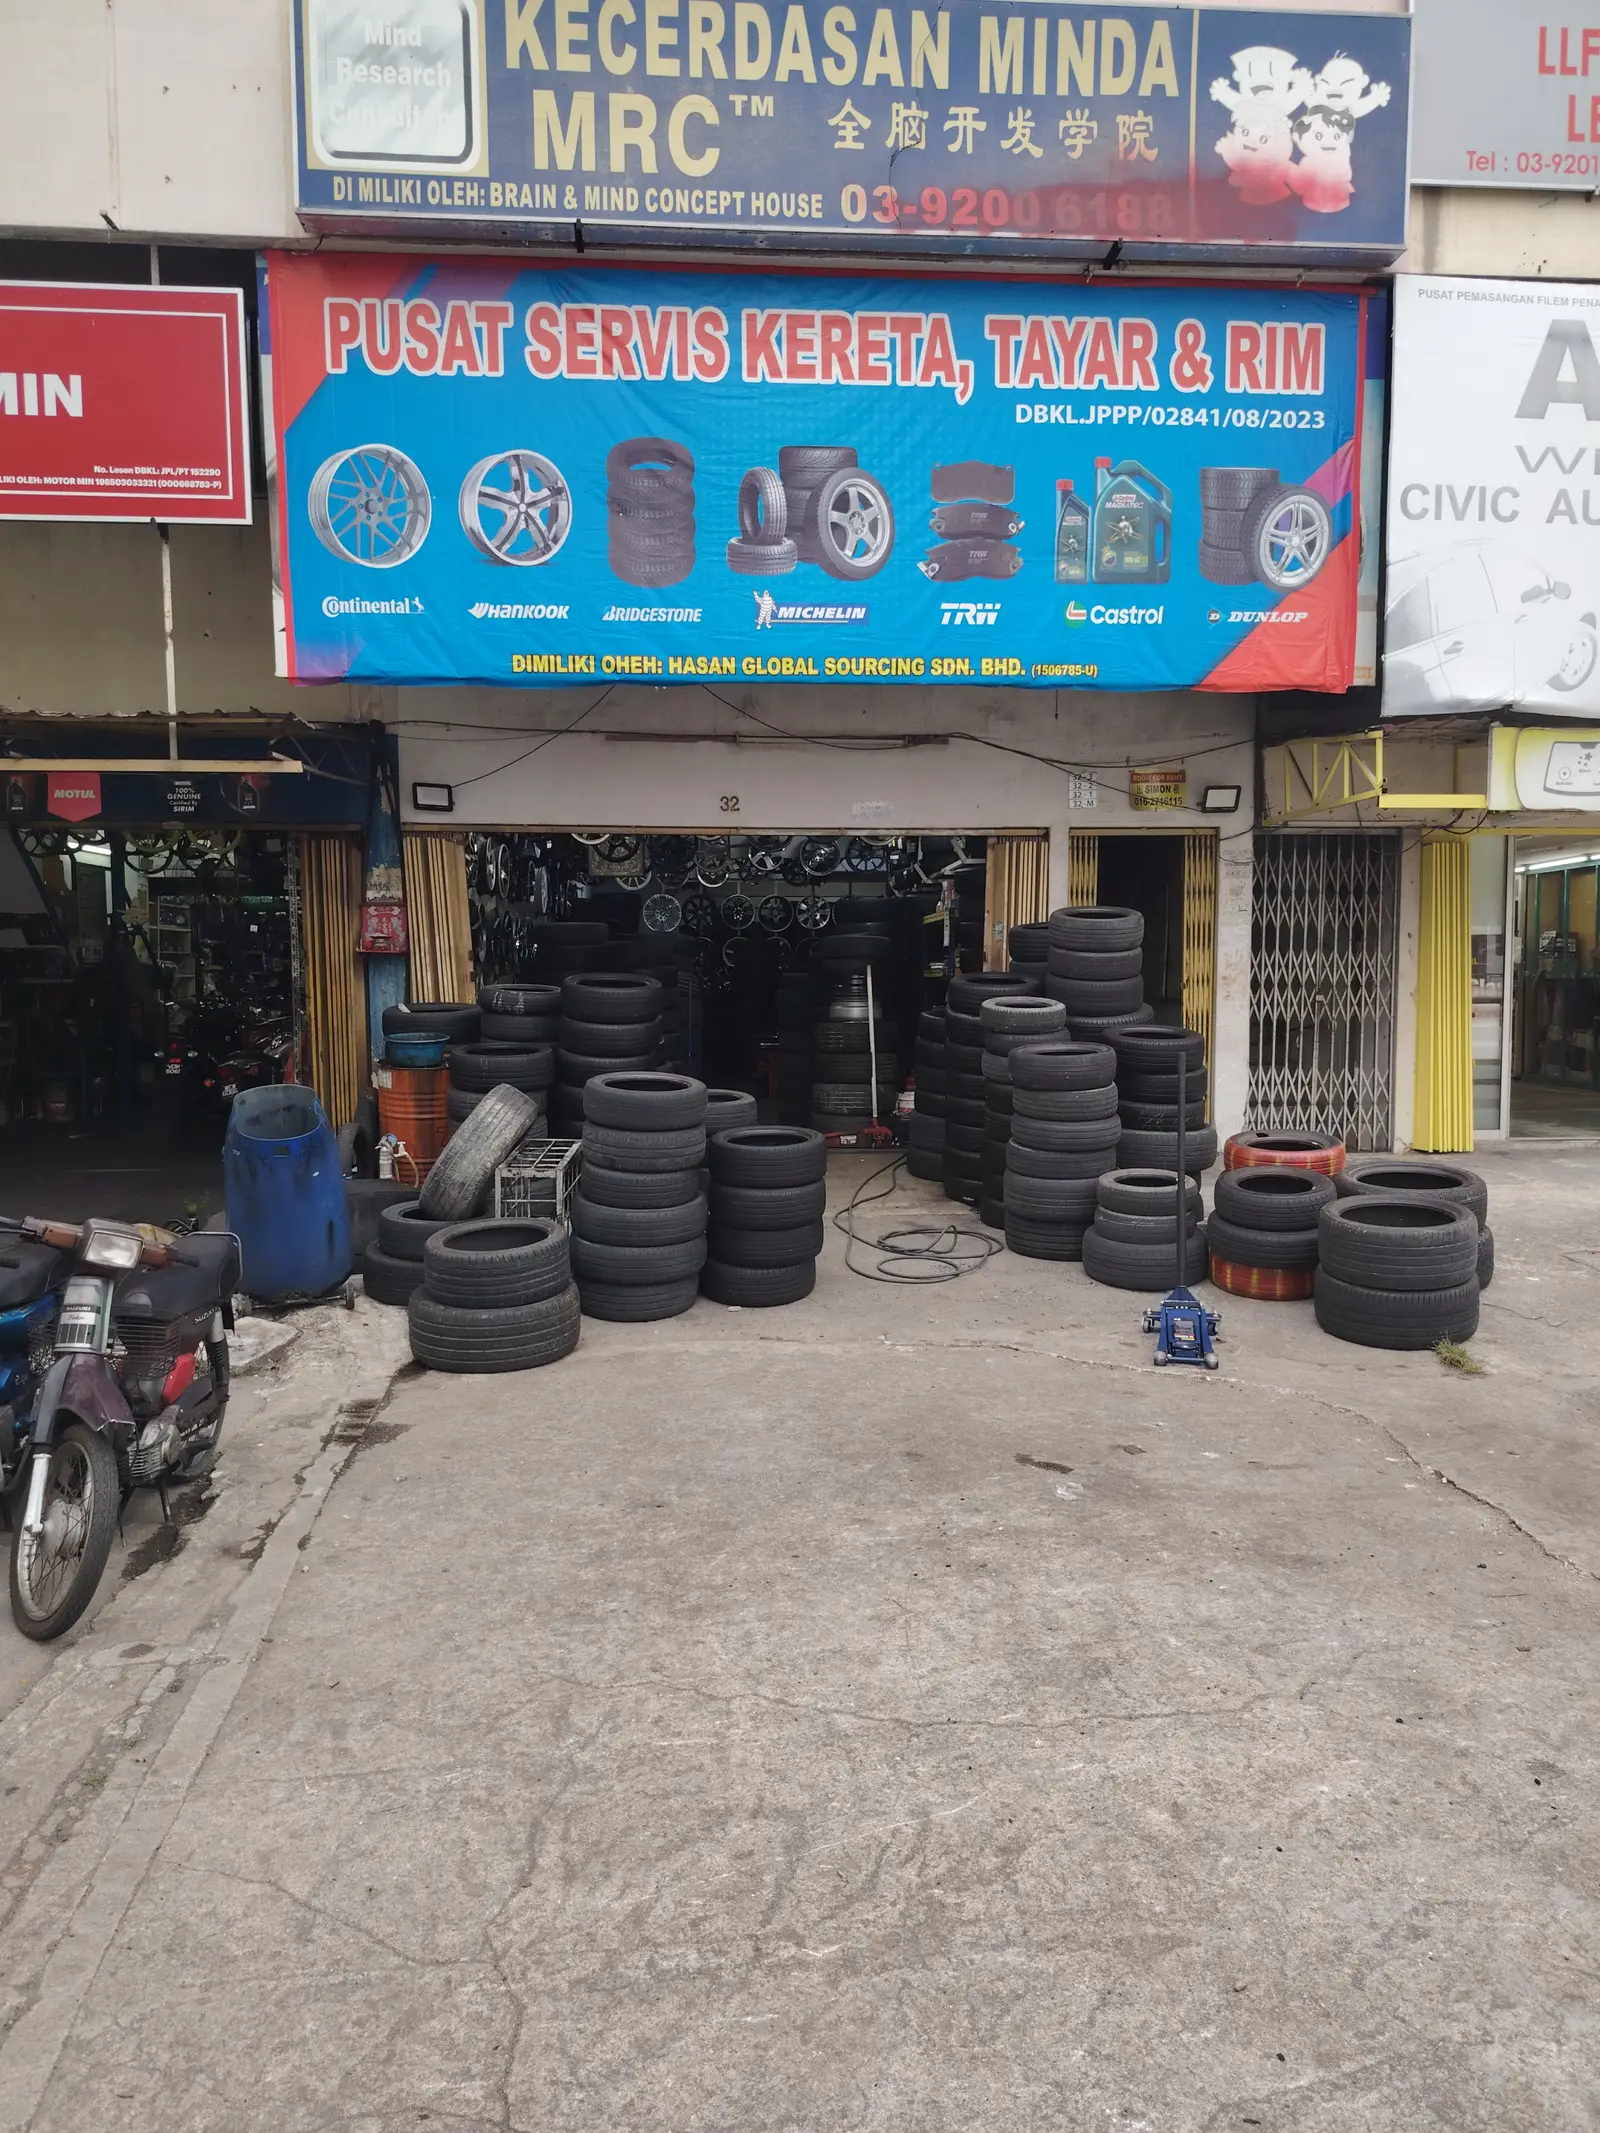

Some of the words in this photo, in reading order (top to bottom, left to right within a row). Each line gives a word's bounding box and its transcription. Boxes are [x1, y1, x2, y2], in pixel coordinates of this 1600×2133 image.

[364, 22, 422, 47] Mind
[505, 0, 950, 91] KECERDASAN
[979, 16, 1179, 98] MINDA
[336, 56, 452, 88] Research
[828, 98, 1158, 162] 全脑开发学院
[333, 176, 354, 203] DI
[358, 178, 421, 207] MILIKI
[427, 180, 486, 208] OLEH:
[489, 182, 557, 210] BRAIN
[563, 185, 579, 211] &
[584, 186, 639, 213] MIND
[643, 187, 746, 217] CONCEPT
[751, 191, 823, 219] HOUSE
[841, 183, 1041, 229] 03-9200
[1418, 288, 1454, 301] PUSAT
[1457, 291, 1534, 304] PEMASANGAN
[1537, 295, 1569, 307] FILEM
[323, 296, 514, 379] PUSAT
[524, 303, 730, 383] SERVIS
[740, 308, 975, 406] KERETA,
[985, 313, 1159, 392] TAYAR
[1170, 317, 1214, 394] &
[1224, 320, 1326, 395] RIM
[1015, 403, 1326, 431] DBKL.JPPP/02841/08/2023
[44, 477, 76, 486] MOTOR
[77, 478, 94, 486] MIN
[1399, 482, 1520, 523] CIVIC
[322, 596, 411, 617] Continental
[602, 605, 702, 622] BRIDGESTONE
[777, 606, 866, 620] MICHELIN
[940, 602, 1002, 625] TRW
[1090, 605, 1164, 625] Castrol
[1227, 611, 1308, 623] DUNLOP
[512, 653, 596, 674] DIMILIKI
[600, 655, 663, 675] OHEH:
[668, 656, 736, 675] HASAN
[741, 657, 819, 676] GLOBAL
[824, 658, 925, 676] SOURCING
[929, 658, 975, 677] SDN.
[981, 659, 1026, 677] BHD.
[1031, 663, 1099, 681] (1506785-U)
[53, 789, 95, 799] MOTUL
[1145, 785, 1171, 794] SIMON
[719, 795, 740, 813] 32
